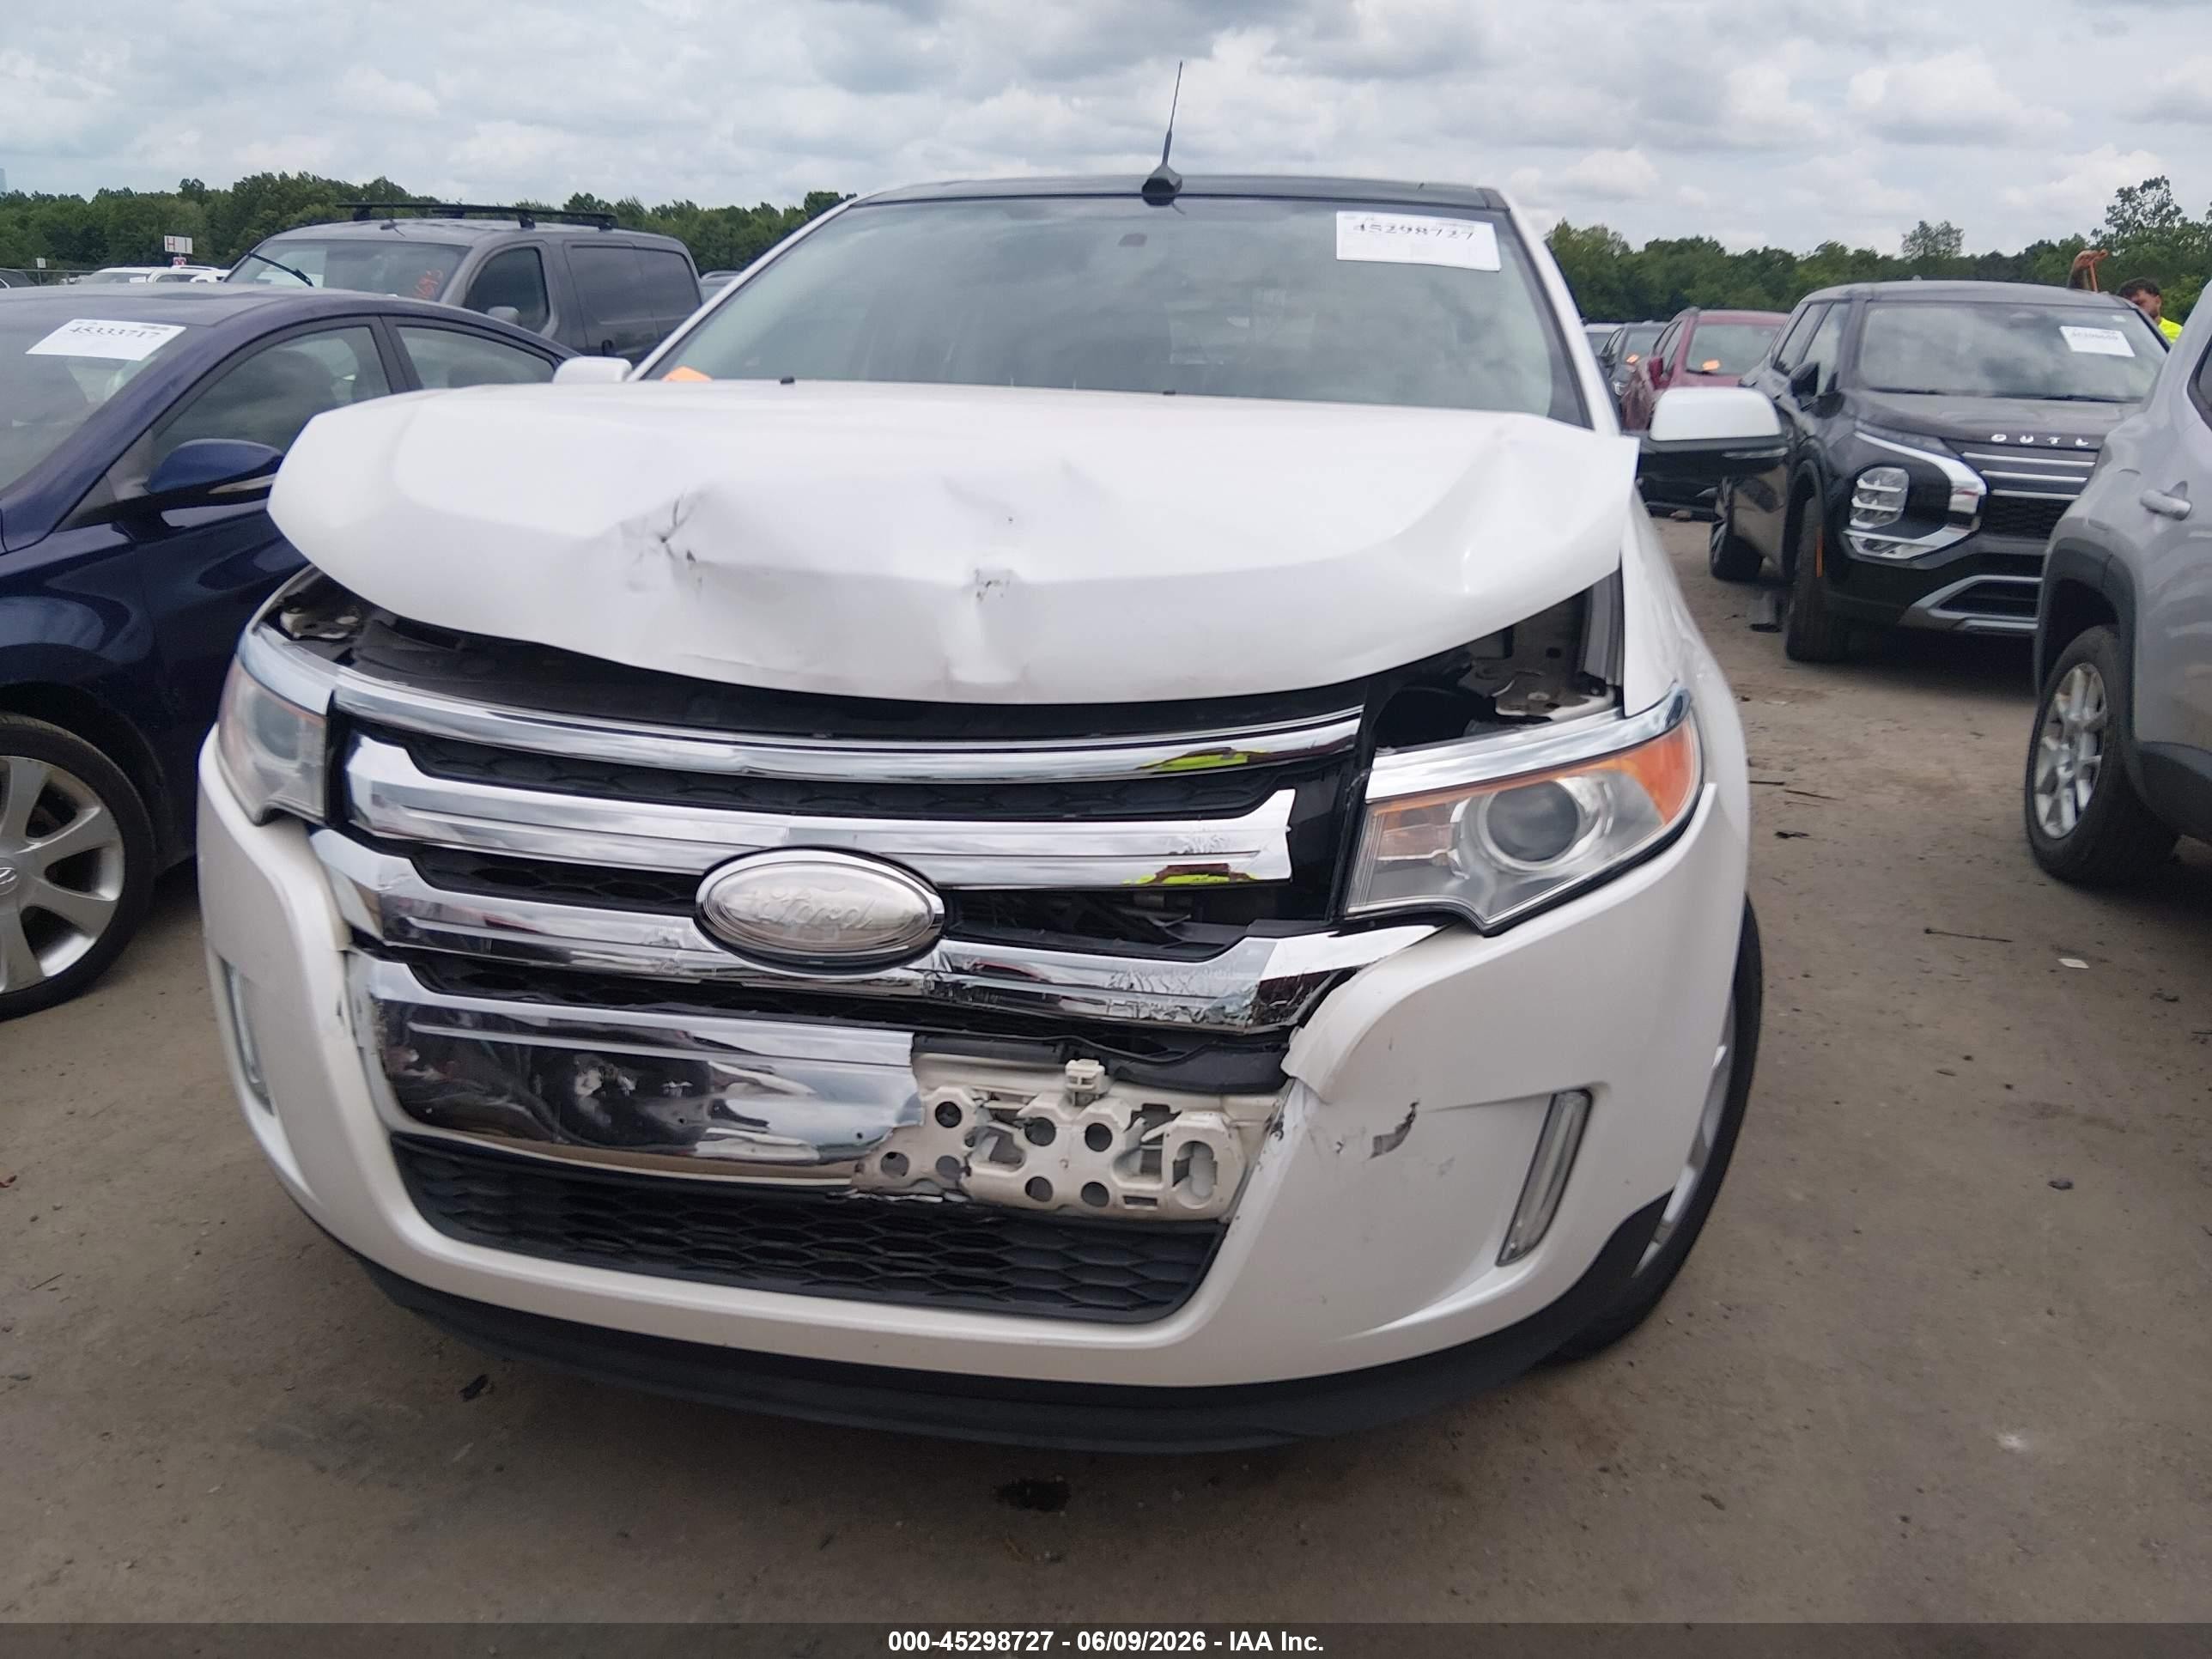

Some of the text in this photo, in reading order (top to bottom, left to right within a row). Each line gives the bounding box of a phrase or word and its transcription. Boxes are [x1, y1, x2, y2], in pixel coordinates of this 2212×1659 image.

[1353, 223, 1474, 240] 45298727
[167, 236, 175, 251] H
[1990, 433, 2089, 447] OUTL
[755, 885, 877, 929] Ford
